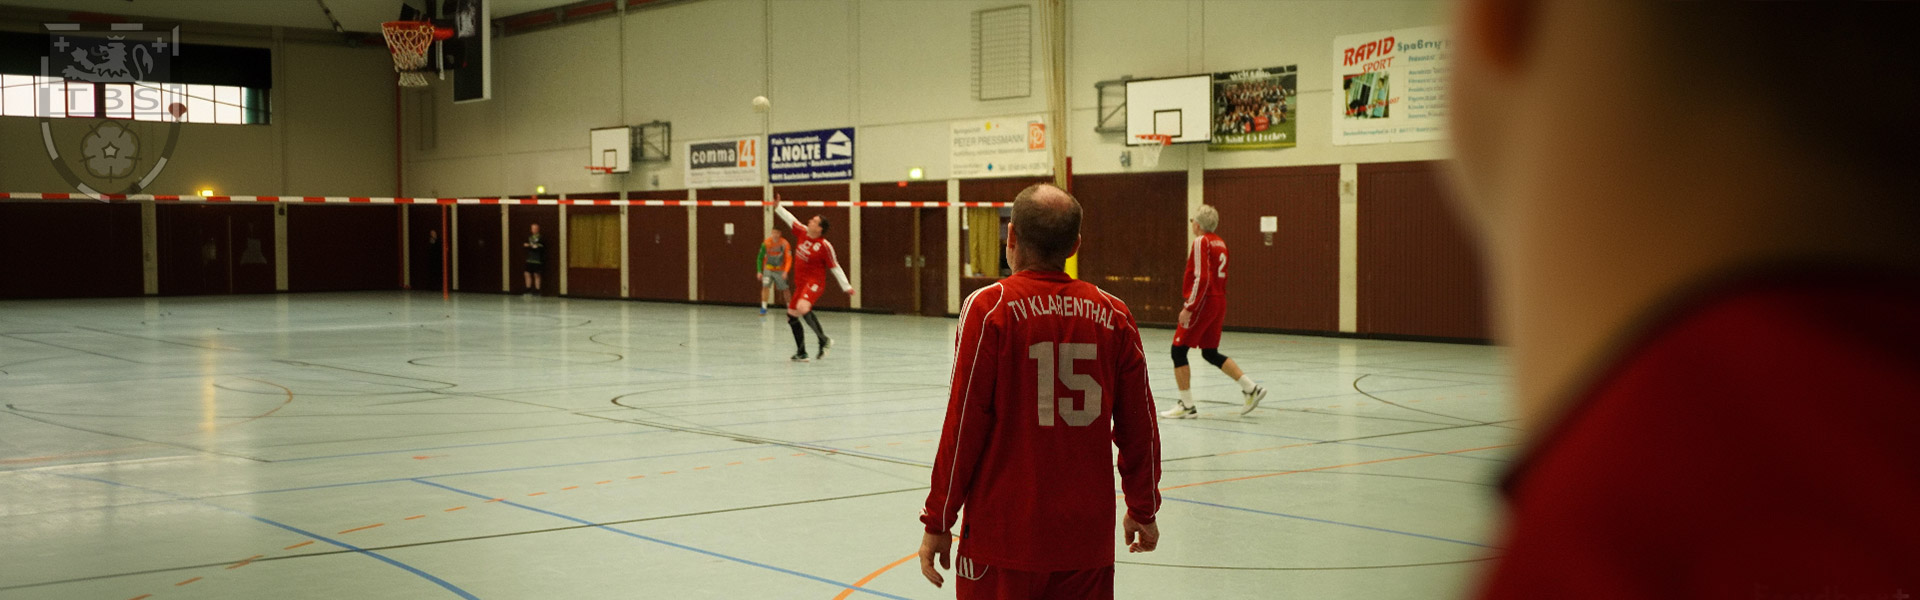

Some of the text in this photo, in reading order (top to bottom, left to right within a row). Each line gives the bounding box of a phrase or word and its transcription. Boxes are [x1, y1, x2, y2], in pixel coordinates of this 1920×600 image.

[1343, 36, 1395, 67] RAPID
[1362, 56, 1395, 74] SPORT
[692, 139, 755, 167] comma 4
[953, 134, 1024, 147] PETER PRESSMANN
[1218, 252, 1227, 278] 2
[1008, 294, 1115, 330] TV KLARENTHAL
[1029, 341, 1103, 427] 15
